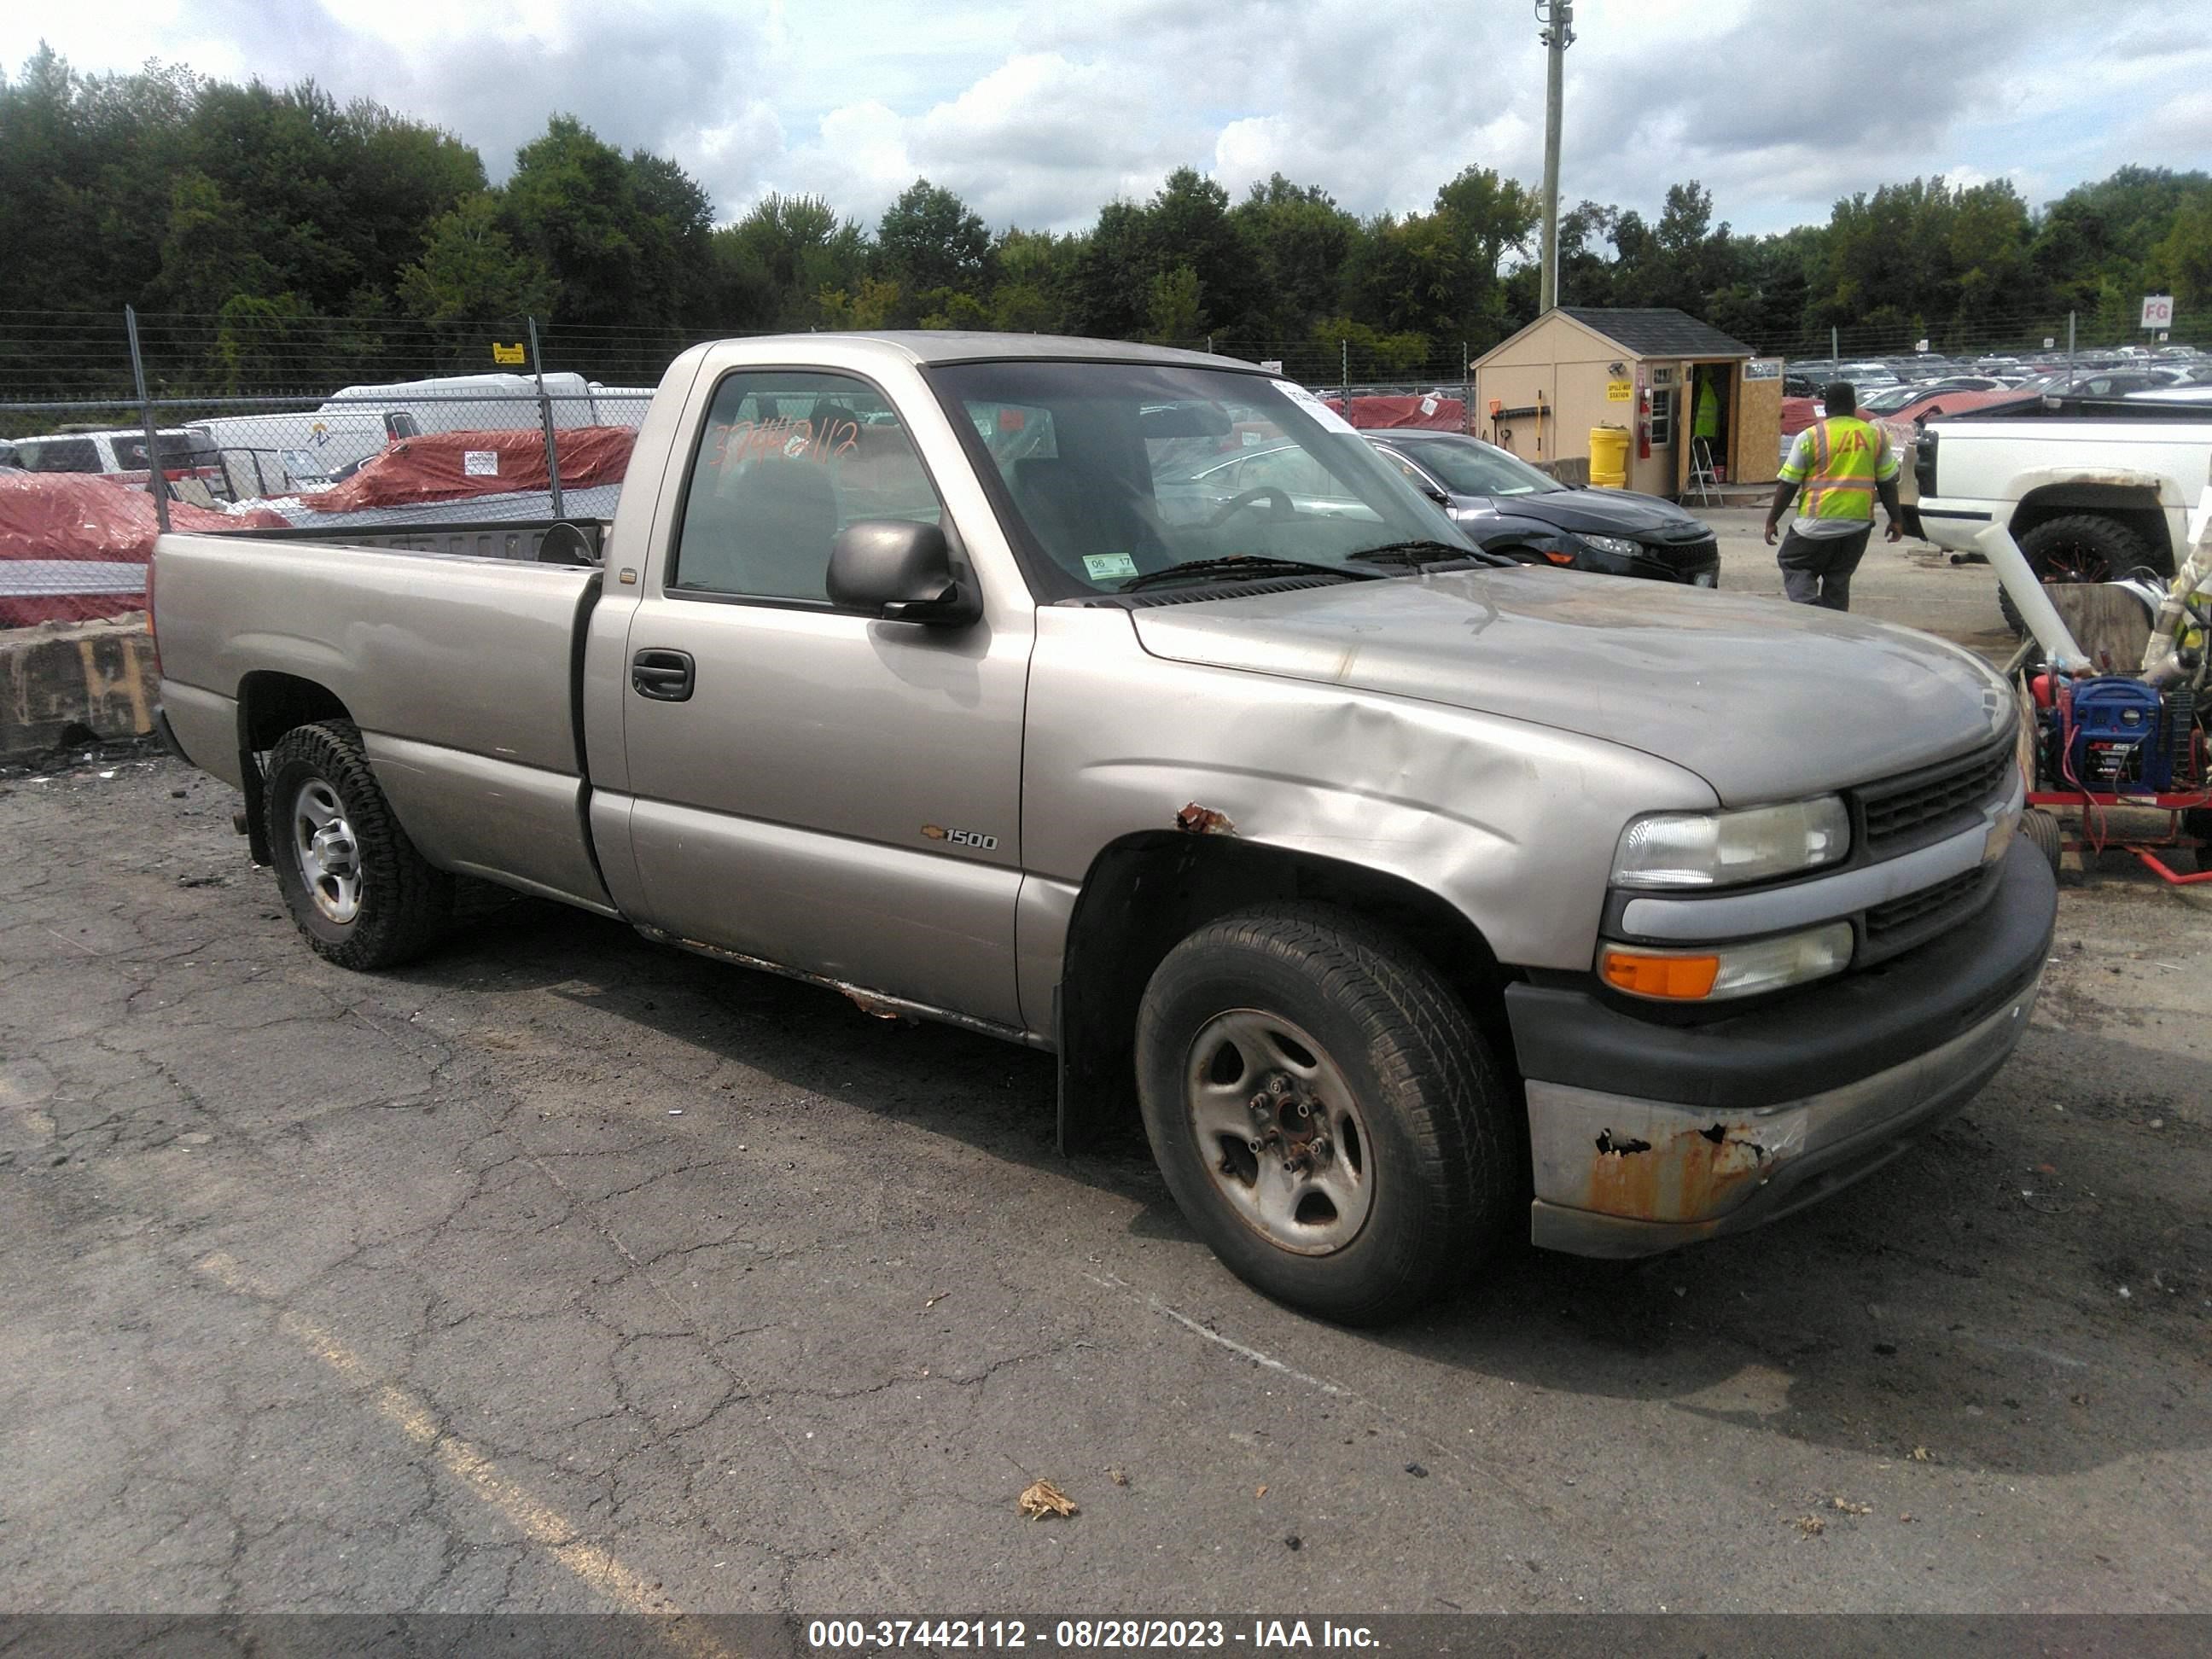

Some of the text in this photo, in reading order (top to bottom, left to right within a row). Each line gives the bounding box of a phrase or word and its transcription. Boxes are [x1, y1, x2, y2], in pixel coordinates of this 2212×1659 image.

[2145, 303, 2168, 319] FG
[1092, 557, 1130, 568] 06 17
[946, 828, 998, 850] 1500
